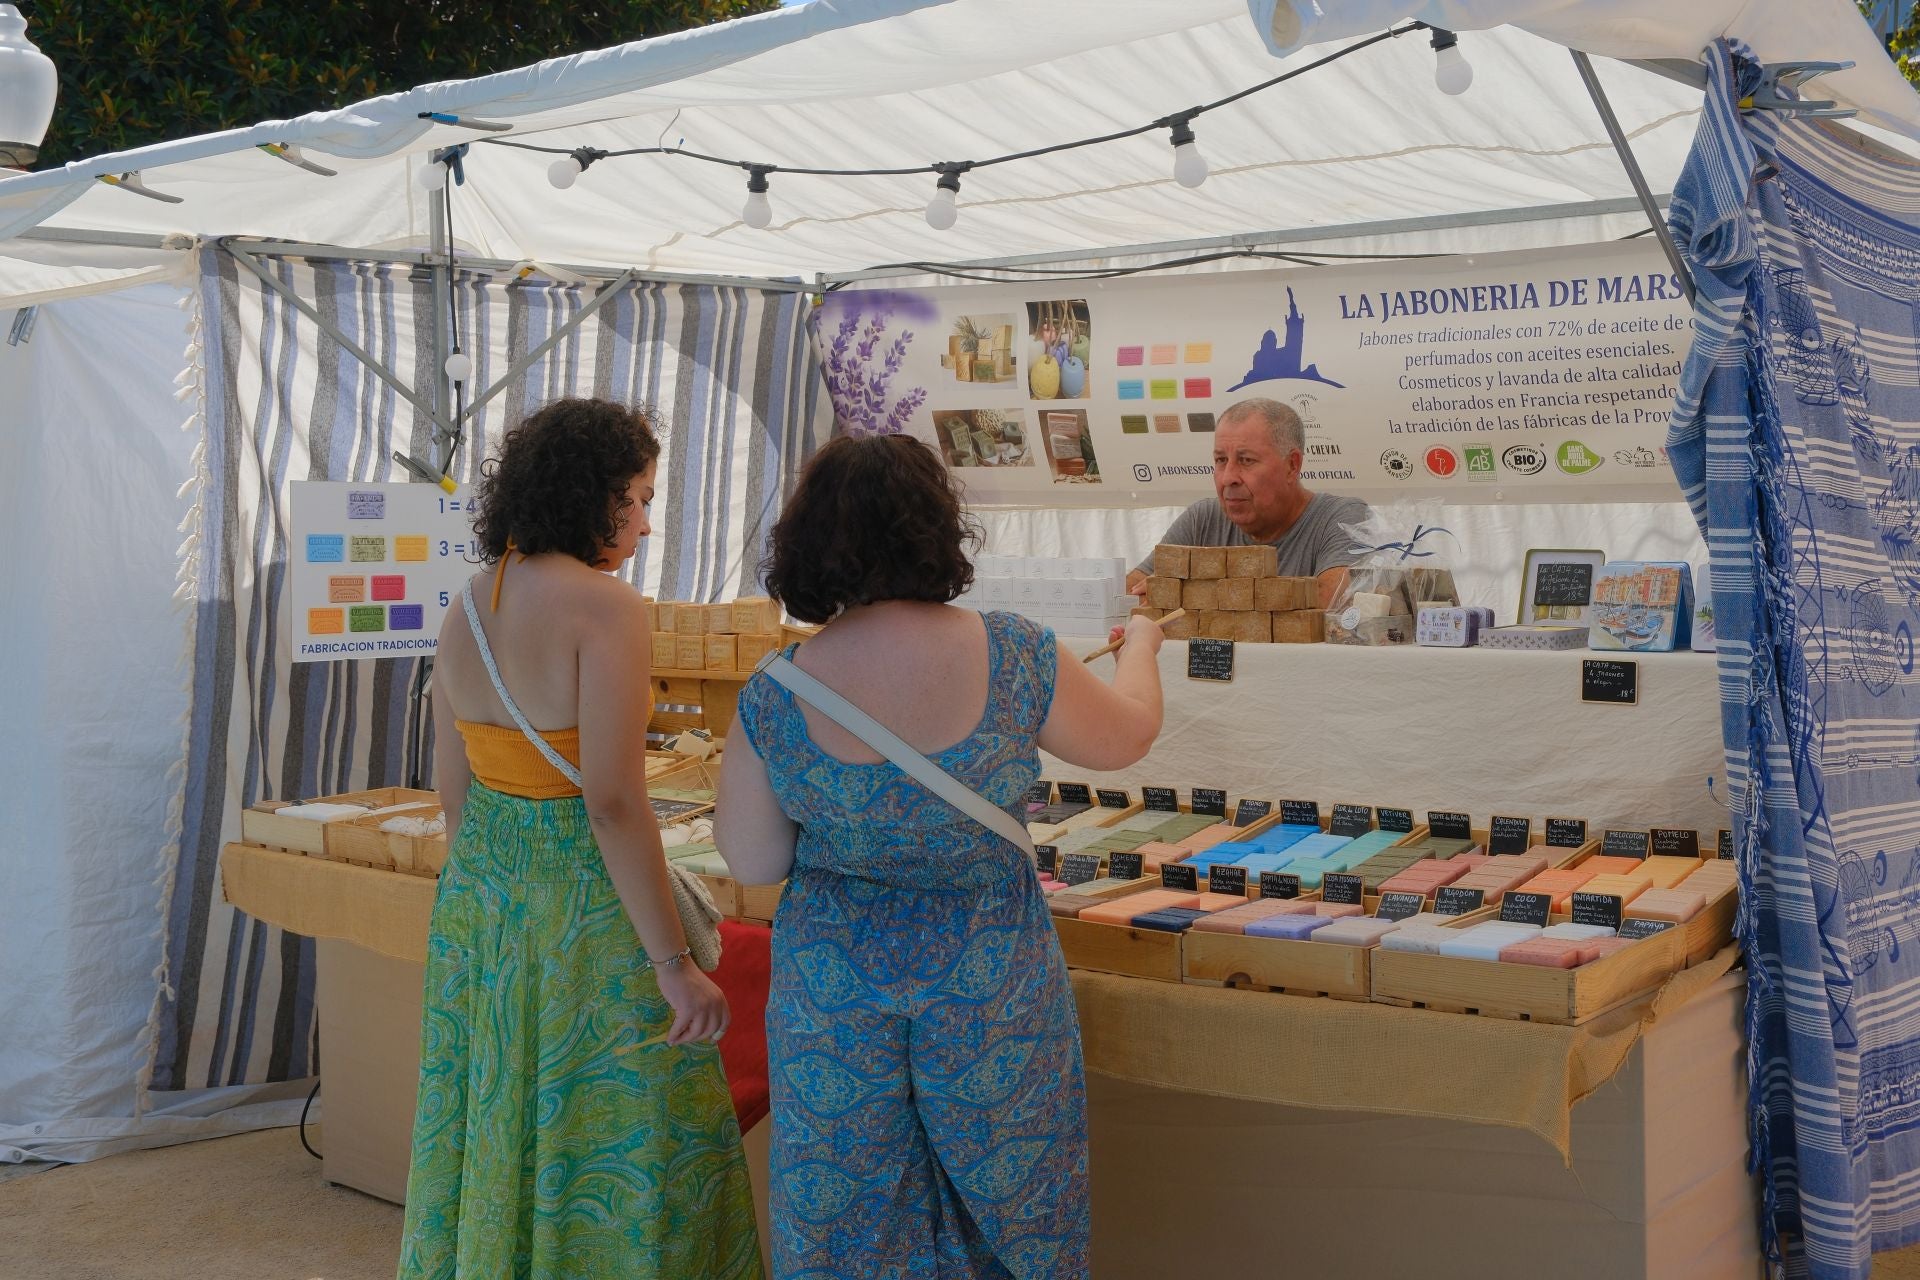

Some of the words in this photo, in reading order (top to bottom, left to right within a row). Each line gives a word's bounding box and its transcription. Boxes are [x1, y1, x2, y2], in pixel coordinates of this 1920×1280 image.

[1339, 294, 1375, 320] LA
[1381, 283, 1541, 324] JABONERIA
[1548, 278, 1589, 308] DE
[1358, 331, 1414, 349] Jabones
[1417, 324, 1512, 345] tradicionales
[1515, 324, 1543, 339] con
[1547, 319, 1583, 338] 72%
[1587, 318, 1607, 336] de
[1610, 315, 1660, 334] aceite
[1663, 313, 1684, 332] de
[1405, 347, 1493, 371] perfumados
[1496, 348, 1523, 364] con
[1527, 345, 1582, 362] aceites
[1585, 340, 1675, 359] esenciales.
[1398, 371, 1482, 391] Cosmeticos
[1485, 375, 1495, 391] y
[1498, 371, 1560, 388] lavanda
[1563, 368, 1583, 385] de
[1587, 366, 1618, 383] alta
[1622, 361, 1683, 380] calidad
[1412, 393, 1494, 413] elaborados
[1497, 396, 1516, 409] en
[1519, 389, 1580, 408] Francia
[1583, 383, 1677, 407] respetando
[1388, 419, 1403, 435] la
[1405, 416, 1472, 434] tradición
[1475, 414, 1495, 431] de
[1498, 413, 1520, 431] las
[1523, 410, 1588, 432] fábricas
[1590, 408, 1611, 426] de
[1614, 408, 1630, 425] la
[1633, 405, 1672, 425] Prov
[1310, 444, 1343, 456] CHEVAL
[1469, 455, 1491, 471] AB
[1514, 454, 1536, 466] BIO
[1318, 470, 1356, 480] OFICIAL
[438, 498, 445, 514] 1
[439, 540, 449, 557] 3
[1551, 564, 1571, 575] CAJA
[439, 591, 449, 608] 5
[301, 641, 375, 654] FABRICACION
[1592, 661, 1609, 669] CAJA
[1146, 788, 1171, 797] TOMILLO
[1380, 809, 1411, 819] VETIVER
[1657, 830, 1689, 839] POMELO
[1387, 894, 1420, 904] LAVANDA
[1514, 894, 1537, 903] COCO
[1573, 893, 1613, 904] ANTARTIDA
[1634, 920, 1665, 931] PAPAYA
